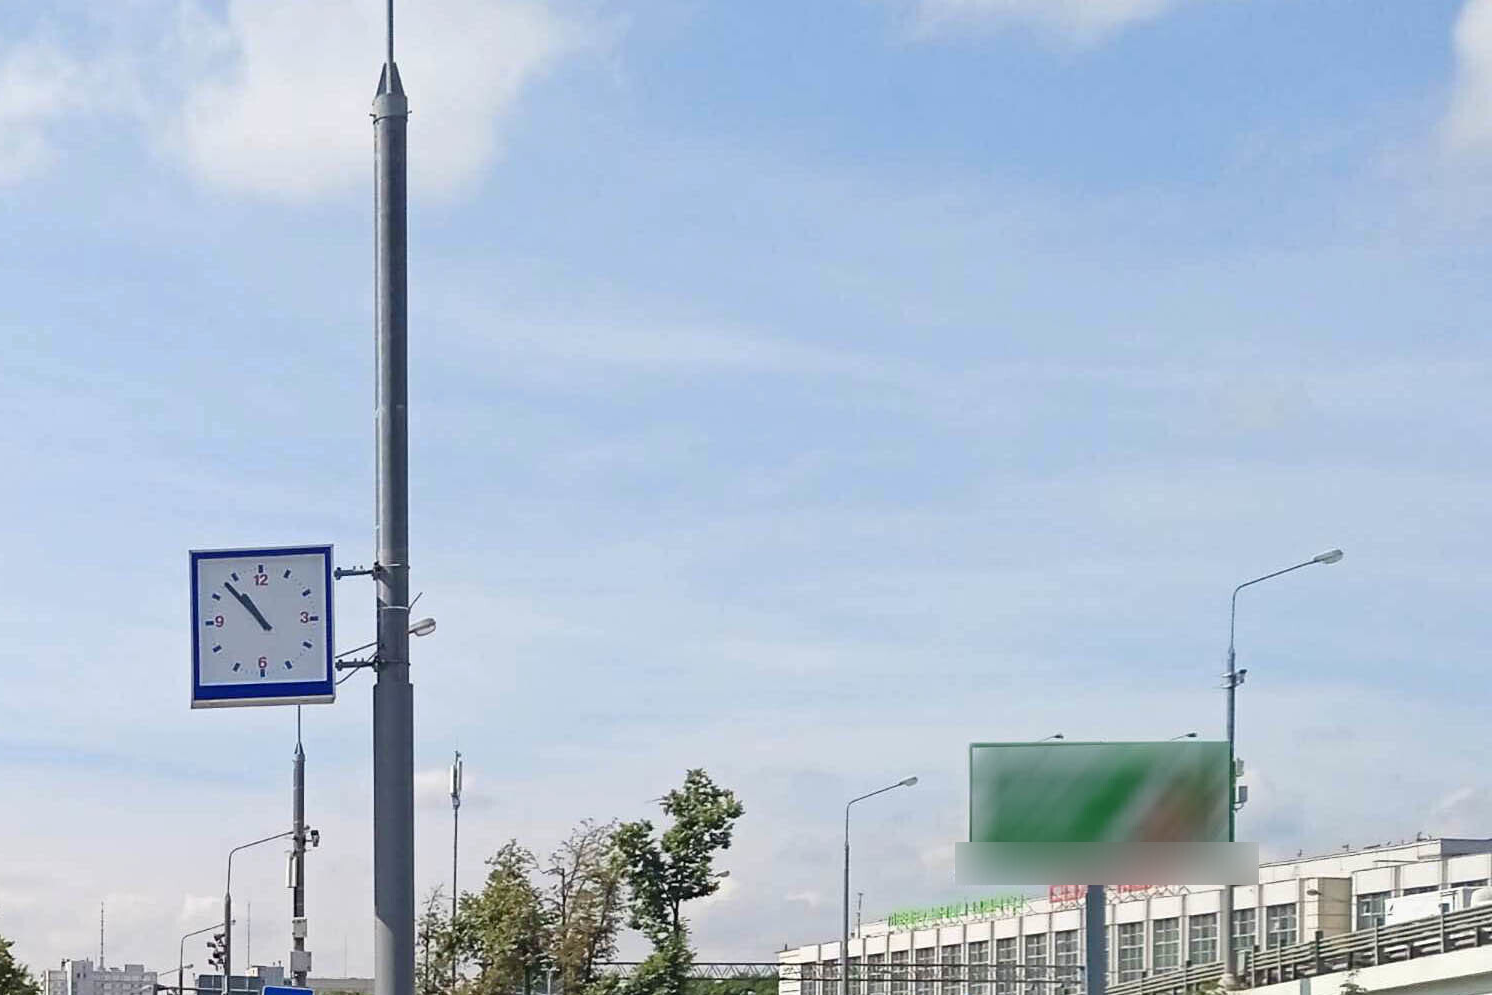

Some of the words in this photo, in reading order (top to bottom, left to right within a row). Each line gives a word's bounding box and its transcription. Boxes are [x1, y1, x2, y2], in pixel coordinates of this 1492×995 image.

[253, 574, 268, 586] 12
[214, 615, 224, 628] 9
[299, 611, 309, 624] 3
[258, 656, 268, 669] 6
